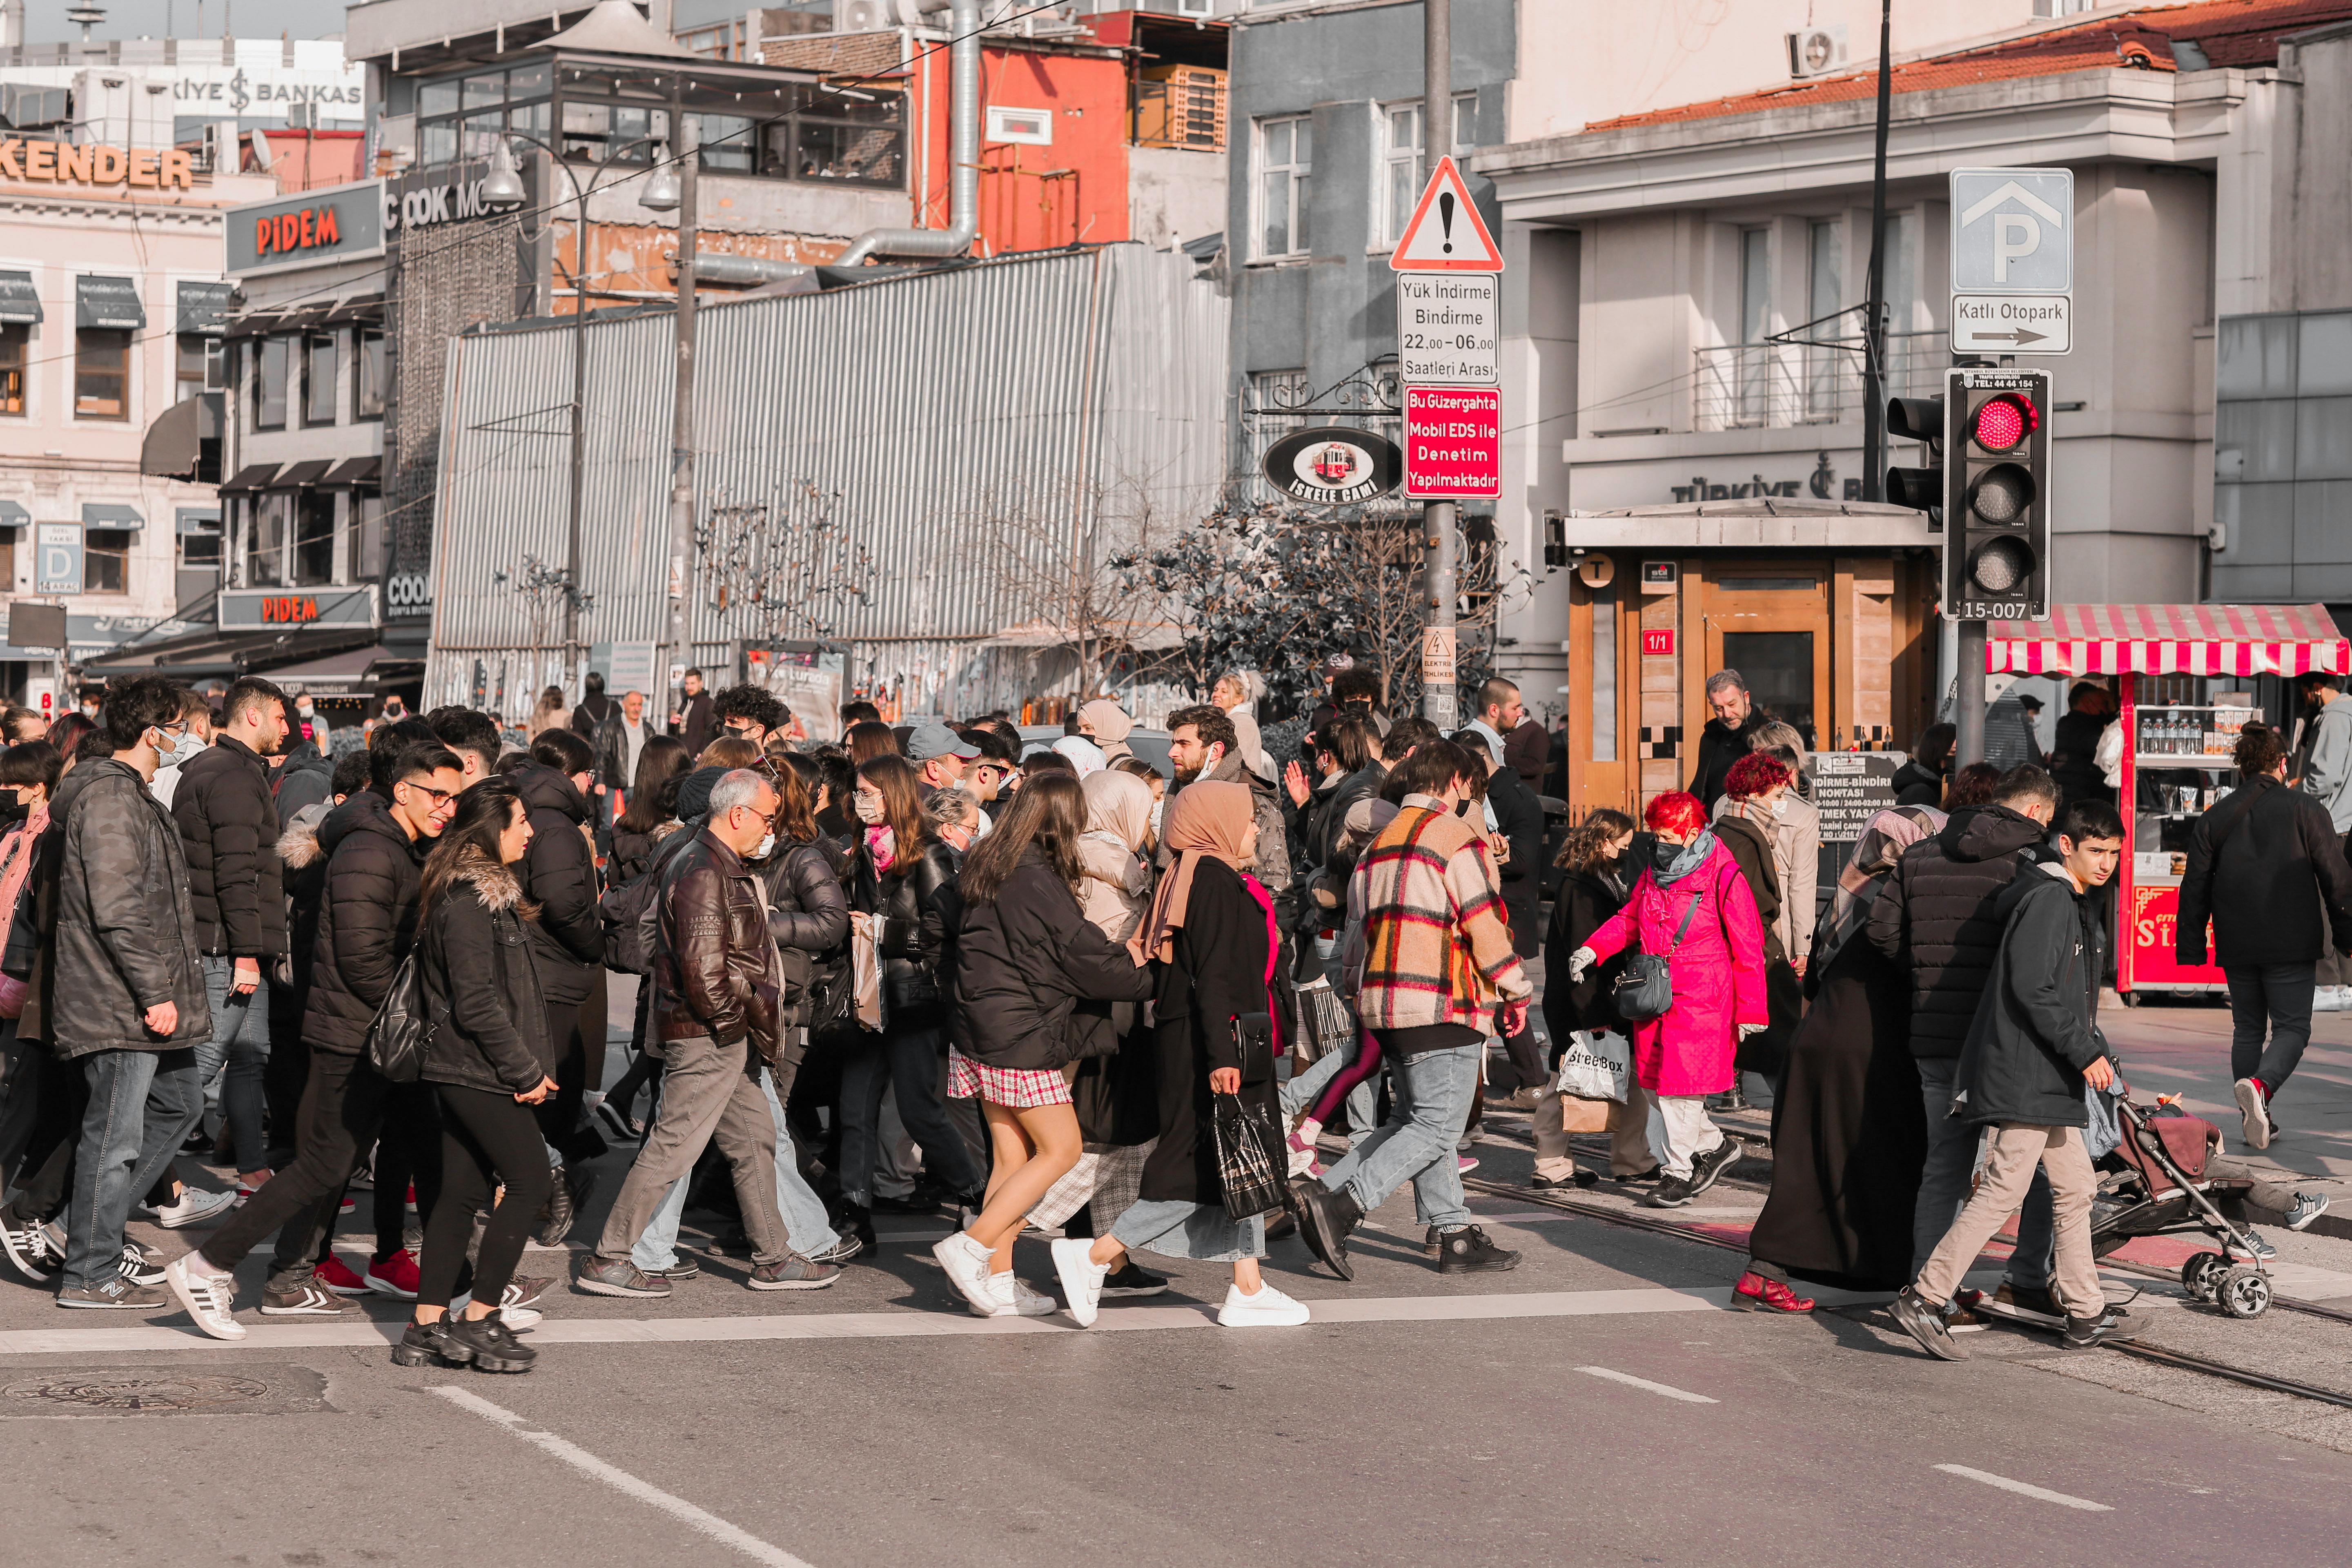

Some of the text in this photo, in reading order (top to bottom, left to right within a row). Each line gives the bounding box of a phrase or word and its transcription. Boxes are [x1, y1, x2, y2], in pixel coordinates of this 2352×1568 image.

[1993, 213, 2041, 283] P
[1402, 280, 1491, 299] Yük İndirme
[1415, 308, 1483, 325] Bindirme
[1959, 302, 2063, 323] Katlı Otopark
[1405, 361, 1493, 377] Saatleri Arası
[1409, 393, 1497, 413] Bu Güzergahta
[1409, 422, 1497, 438] Mobil EDS ile
[1418, 447, 1488, 461] Denetim
[1409, 472, 1498, 490] Yapılmaktadır
[1288, 478, 1379, 503] İSKELE CAMİ
[46, 548, 72, 578] D
[1590, 561, 1604, 579] T
[1965, 602, 2026, 619] 15-007
[1649, 635, 1666, 650] 1/1
[1819, 788, 1864, 797] NOKTASI
[1820, 821, 1842, 830] TARİHİ
